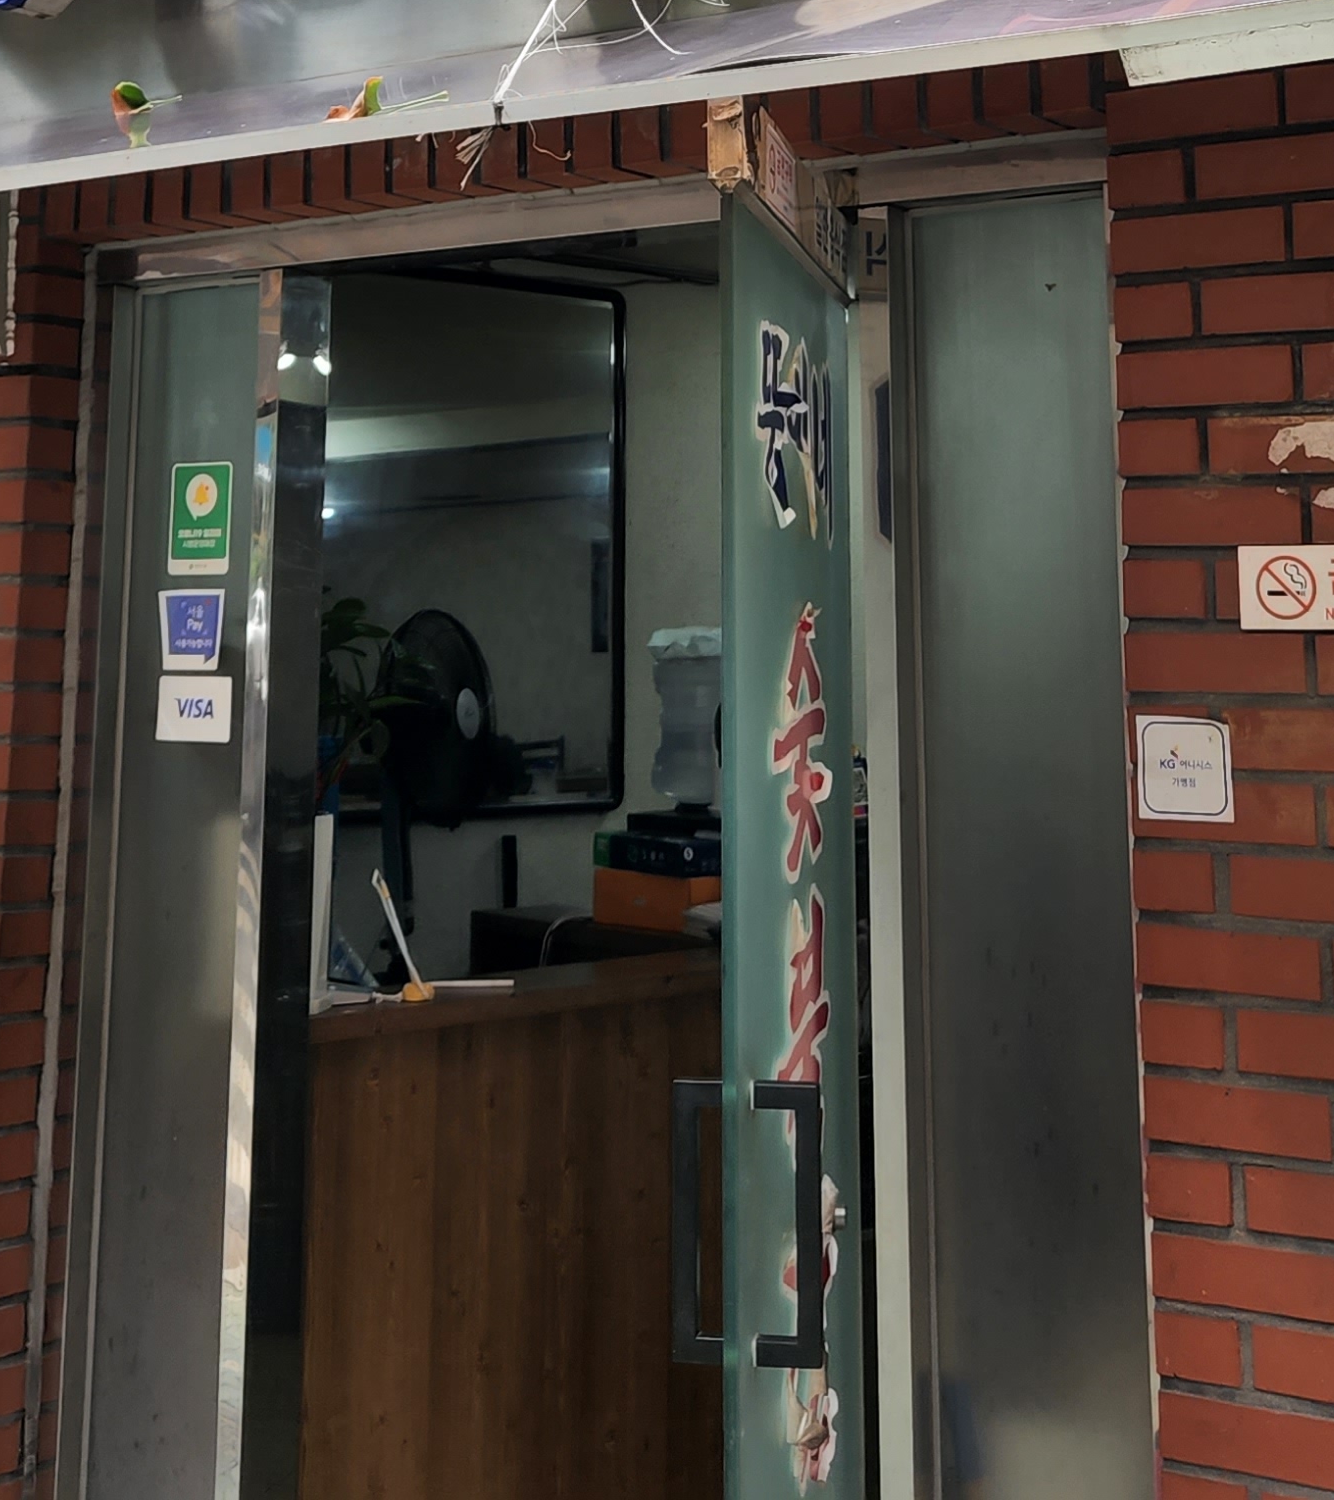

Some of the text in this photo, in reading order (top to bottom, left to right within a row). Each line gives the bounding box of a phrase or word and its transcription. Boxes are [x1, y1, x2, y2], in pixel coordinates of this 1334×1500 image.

[174, 698, 214, 719] VISA
[1159, 758, 1176, 770] KG
[1172, 777, 1196, 788] 가맹점
